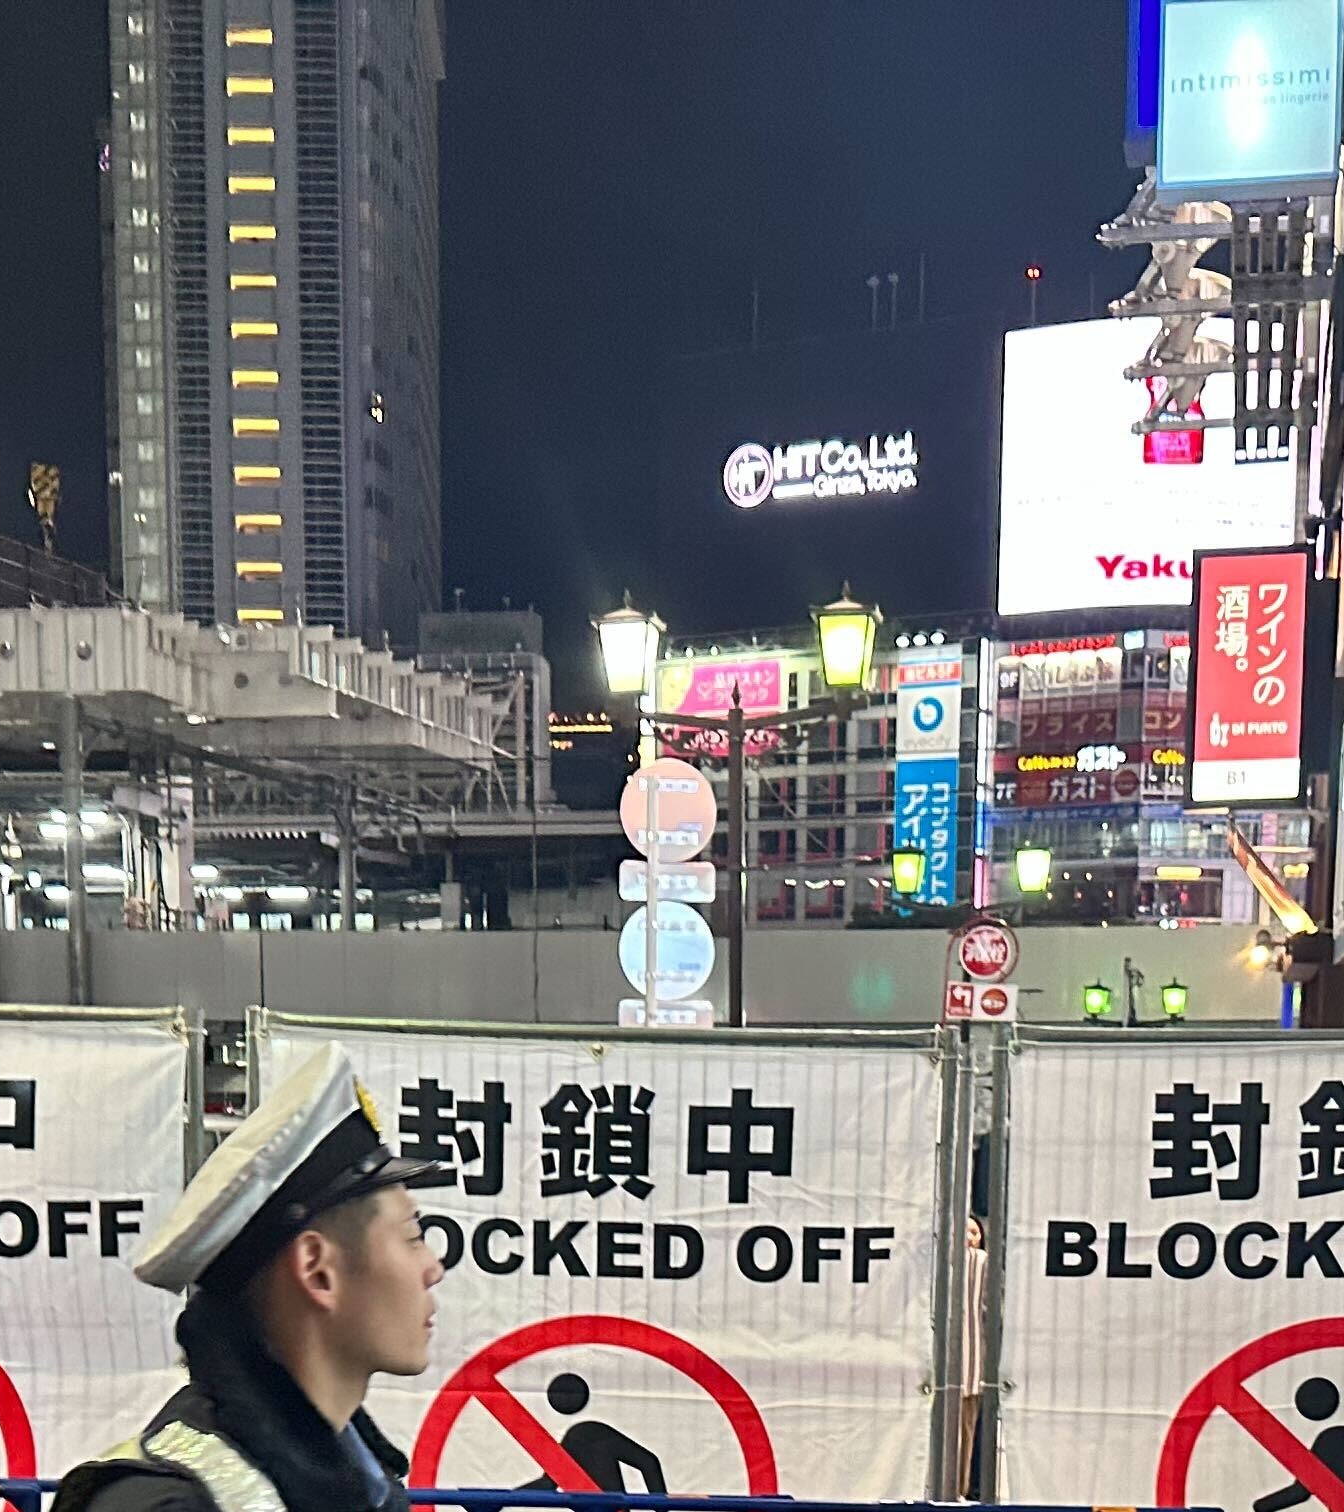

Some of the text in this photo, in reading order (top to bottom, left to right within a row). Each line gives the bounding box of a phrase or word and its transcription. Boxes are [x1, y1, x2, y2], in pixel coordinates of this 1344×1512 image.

[1171, 67, 1330, 93] intimissimi
[1214, 584, 1251, 672] 酒場。
[1252, 583, 1289, 706] ワインの
[1049, 777, 1105, 802] ガスト
[1227, 770, 1247, 786] B1
[397, 1077, 795, 1204] 封鎖中
[416, 1213, 895, 1284] OCKED OFF
